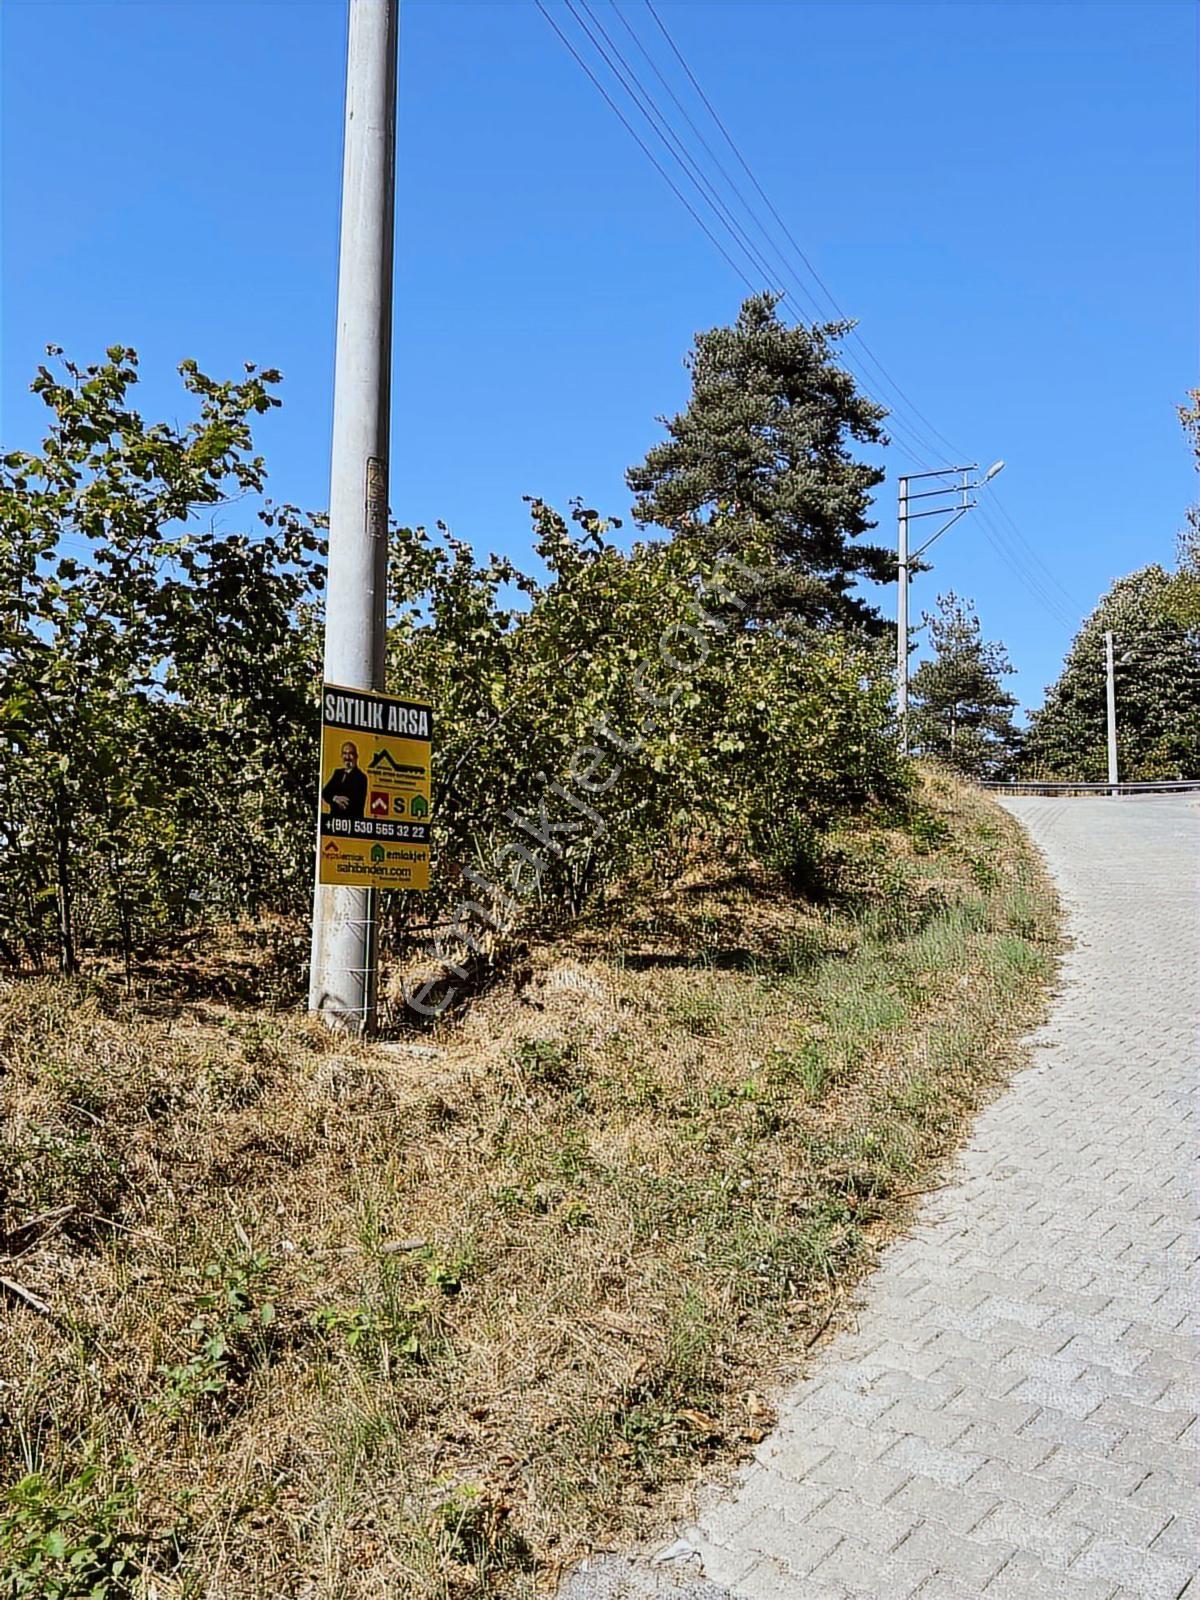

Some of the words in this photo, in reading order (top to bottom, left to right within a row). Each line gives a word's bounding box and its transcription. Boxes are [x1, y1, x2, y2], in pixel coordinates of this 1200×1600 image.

[325, 693, 383, 729] SATILIK
[388, 705, 429, 736] ARSA
[393, 797, 406, 813] S
[325, 818, 352, 834] +(90)
[354, 820, 373, 833] 530
[375, 823, 394, 836] 565
[396, 825, 410, 837] 32
[412, 826, 425, 838] 22
[386, 850, 426, 863] emlakjet
[337, 861, 412, 876] sahibinden.com
